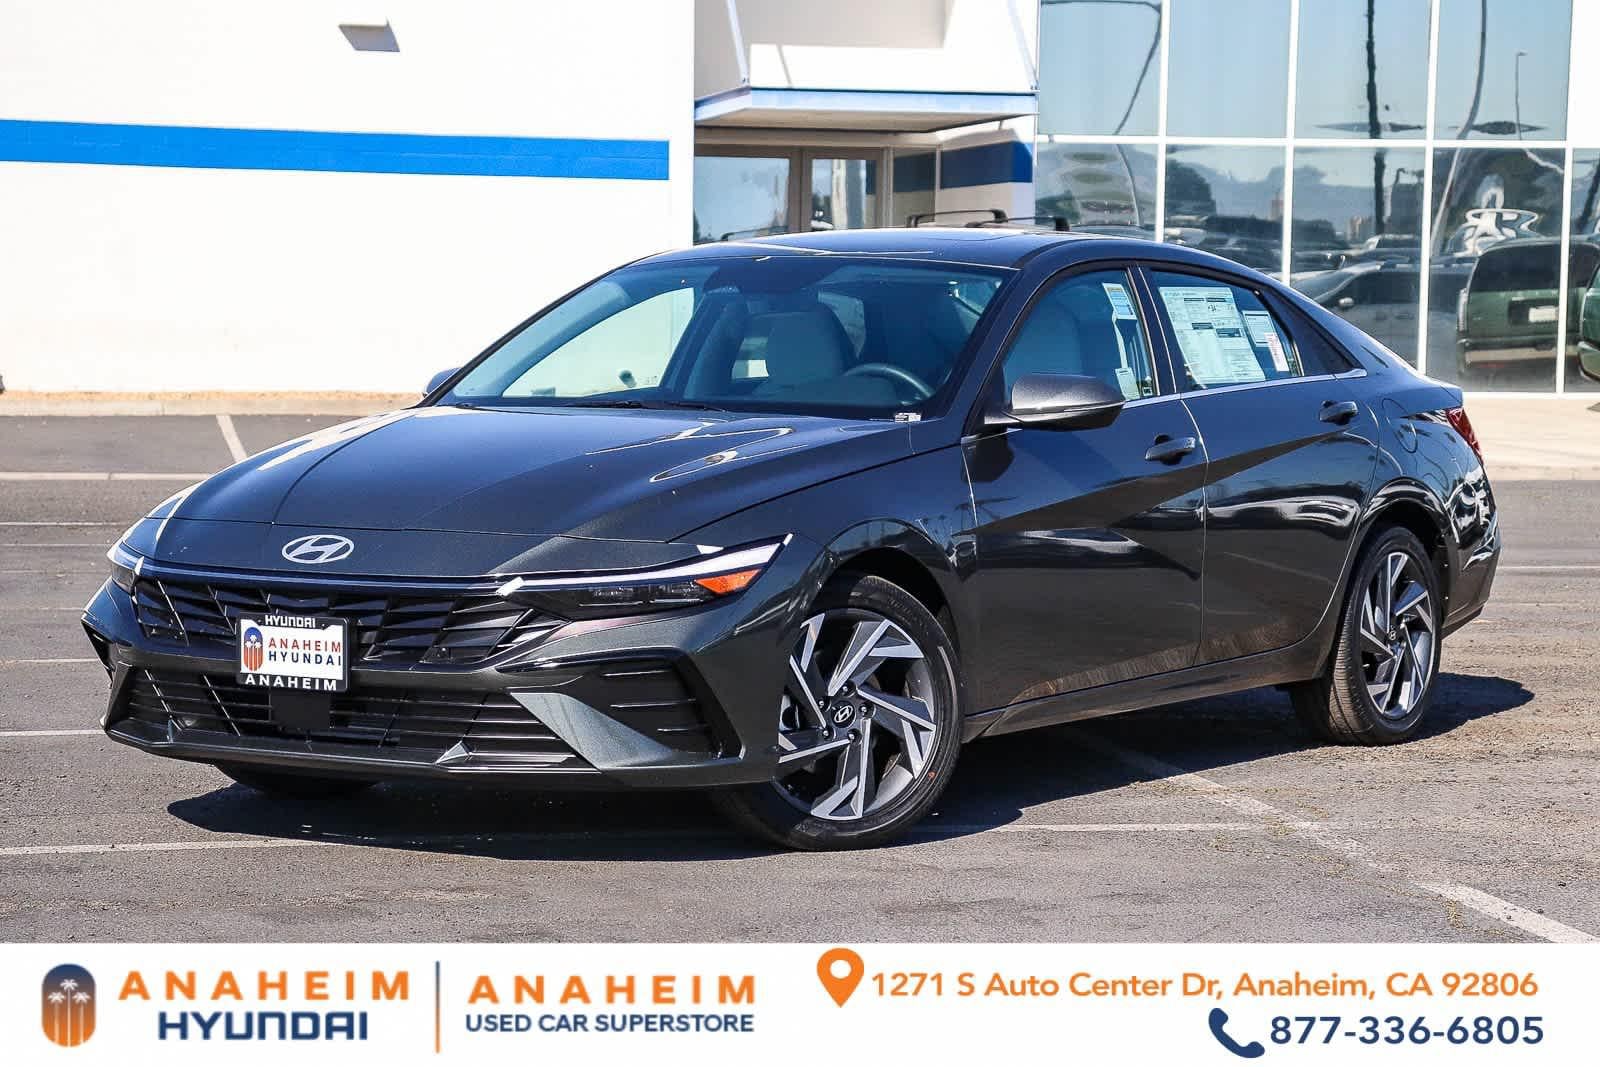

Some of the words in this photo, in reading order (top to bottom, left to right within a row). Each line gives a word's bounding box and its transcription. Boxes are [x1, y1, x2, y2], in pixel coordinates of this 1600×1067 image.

[264, 614, 316, 628] HYUNDAI
[268, 637, 342, 653] ANAHEIM
[268, 651, 342, 666] HYUNDAI
[245, 674, 337, 691] ANAHEIM
